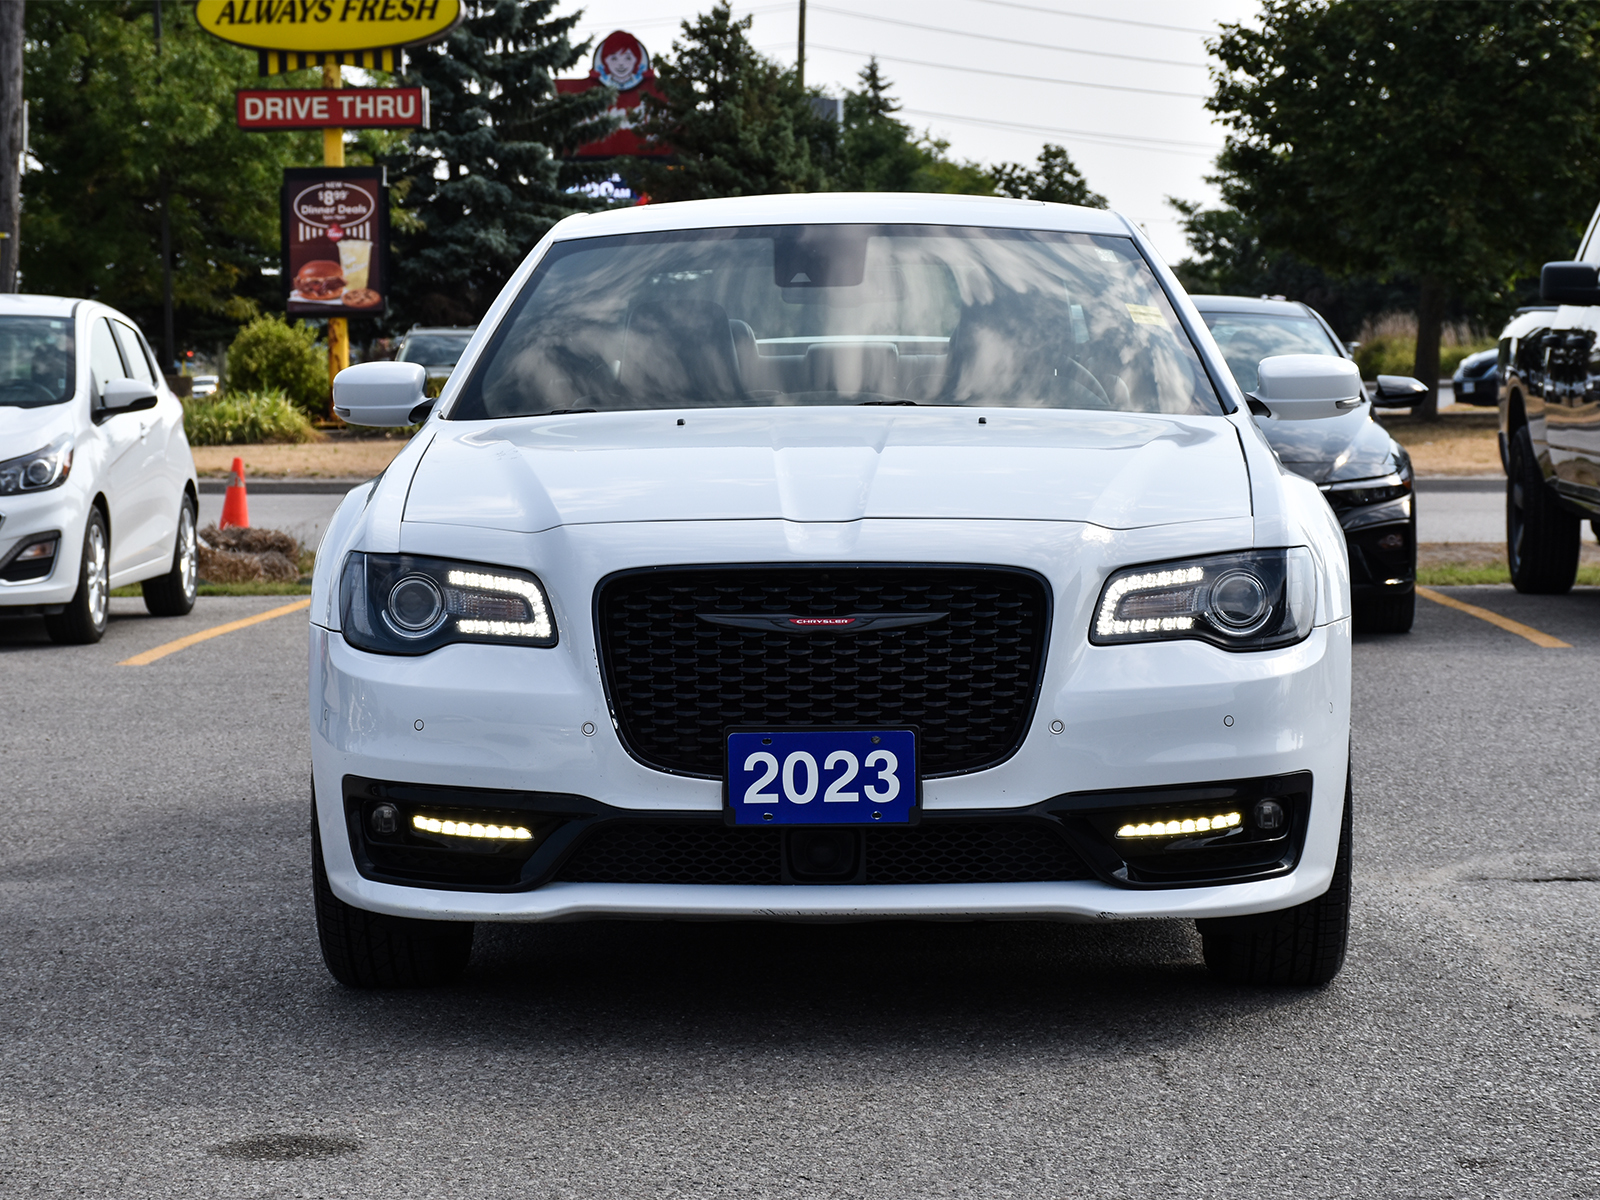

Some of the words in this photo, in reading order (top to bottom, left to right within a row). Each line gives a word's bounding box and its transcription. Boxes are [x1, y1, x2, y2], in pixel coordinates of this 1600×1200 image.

[214, 0, 334, 25] ALWAYS
[339, 0, 438, 22] FRESH
[244, 97, 329, 120] DRIVE
[337, 95, 415, 118] THRU
[325, 181, 343, 189] NEW
[301, 204, 336, 215] Dinner
[337, 203, 367, 214] Deals
[743, 749, 901, 804] 2023
